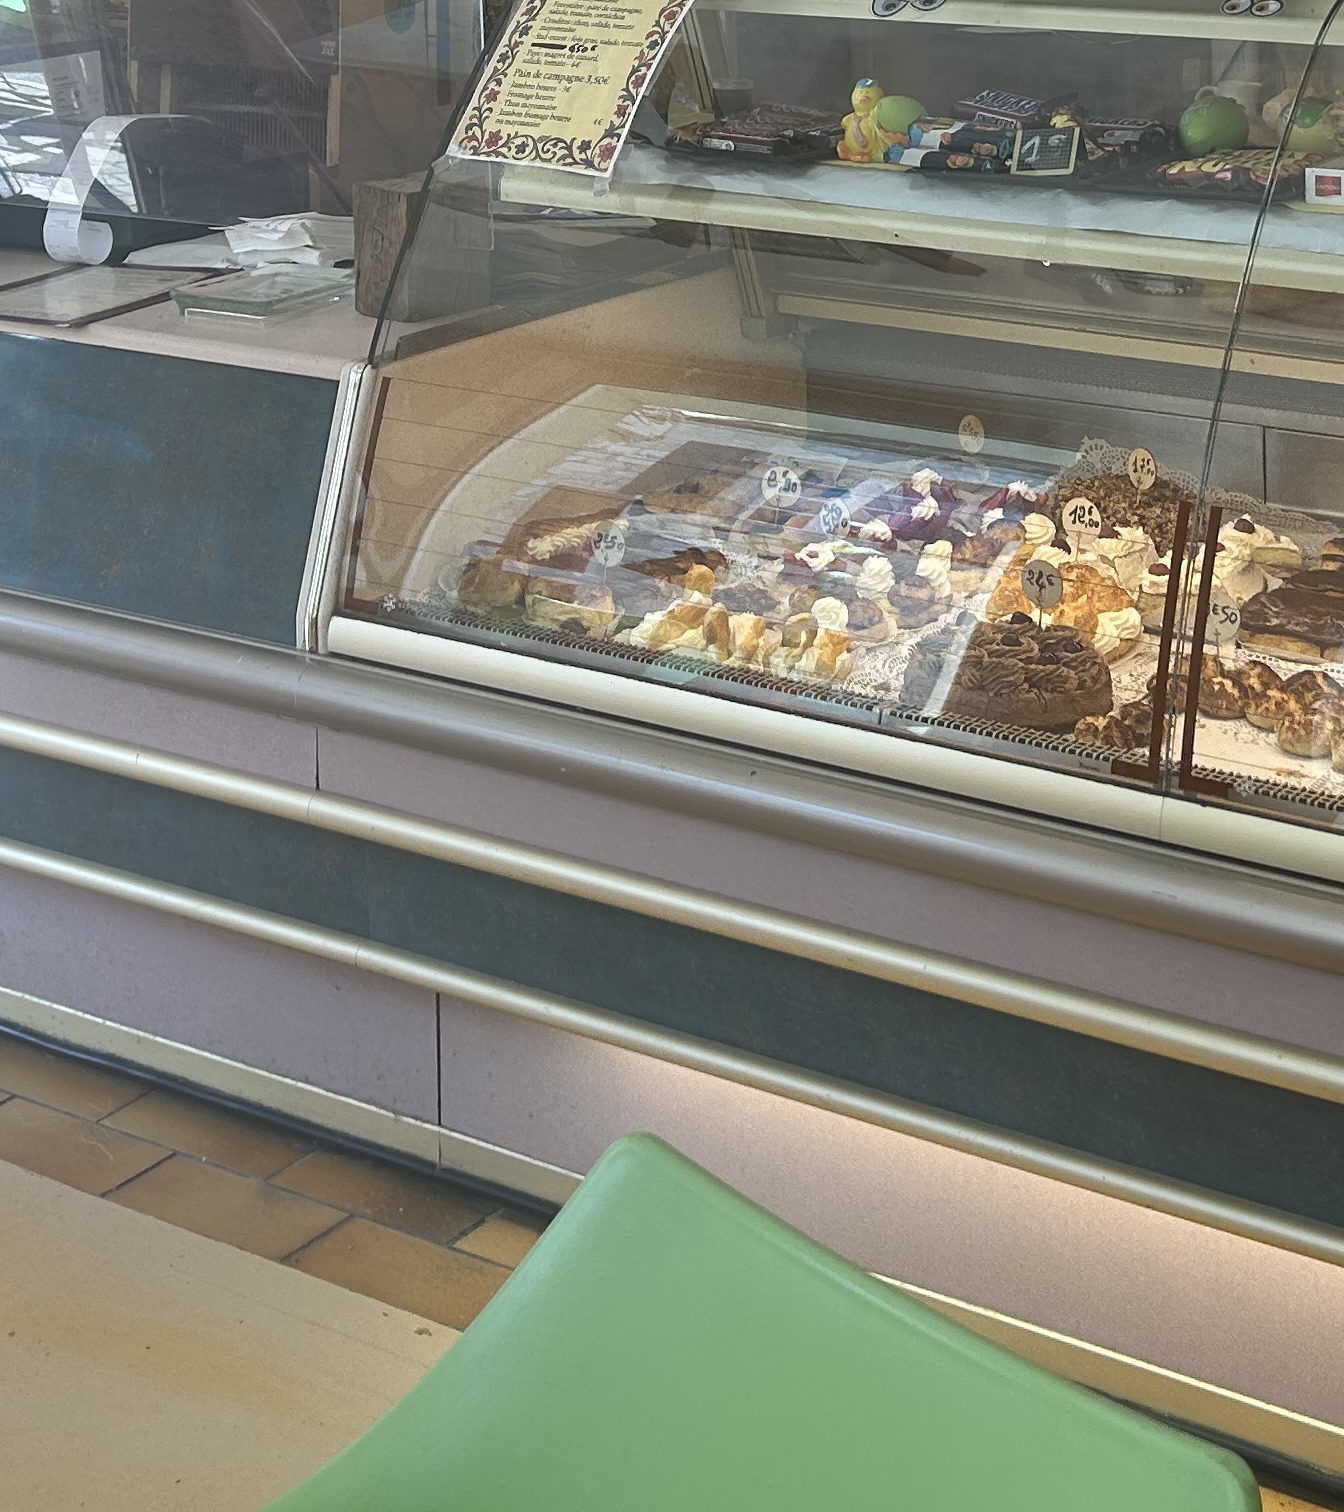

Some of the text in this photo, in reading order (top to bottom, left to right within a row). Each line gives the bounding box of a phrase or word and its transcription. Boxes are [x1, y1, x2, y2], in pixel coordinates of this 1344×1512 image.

[513, 68, 531, 77] Pain
[532, 69, 542, 78] de
[543, 73, 585, 84] campagne
